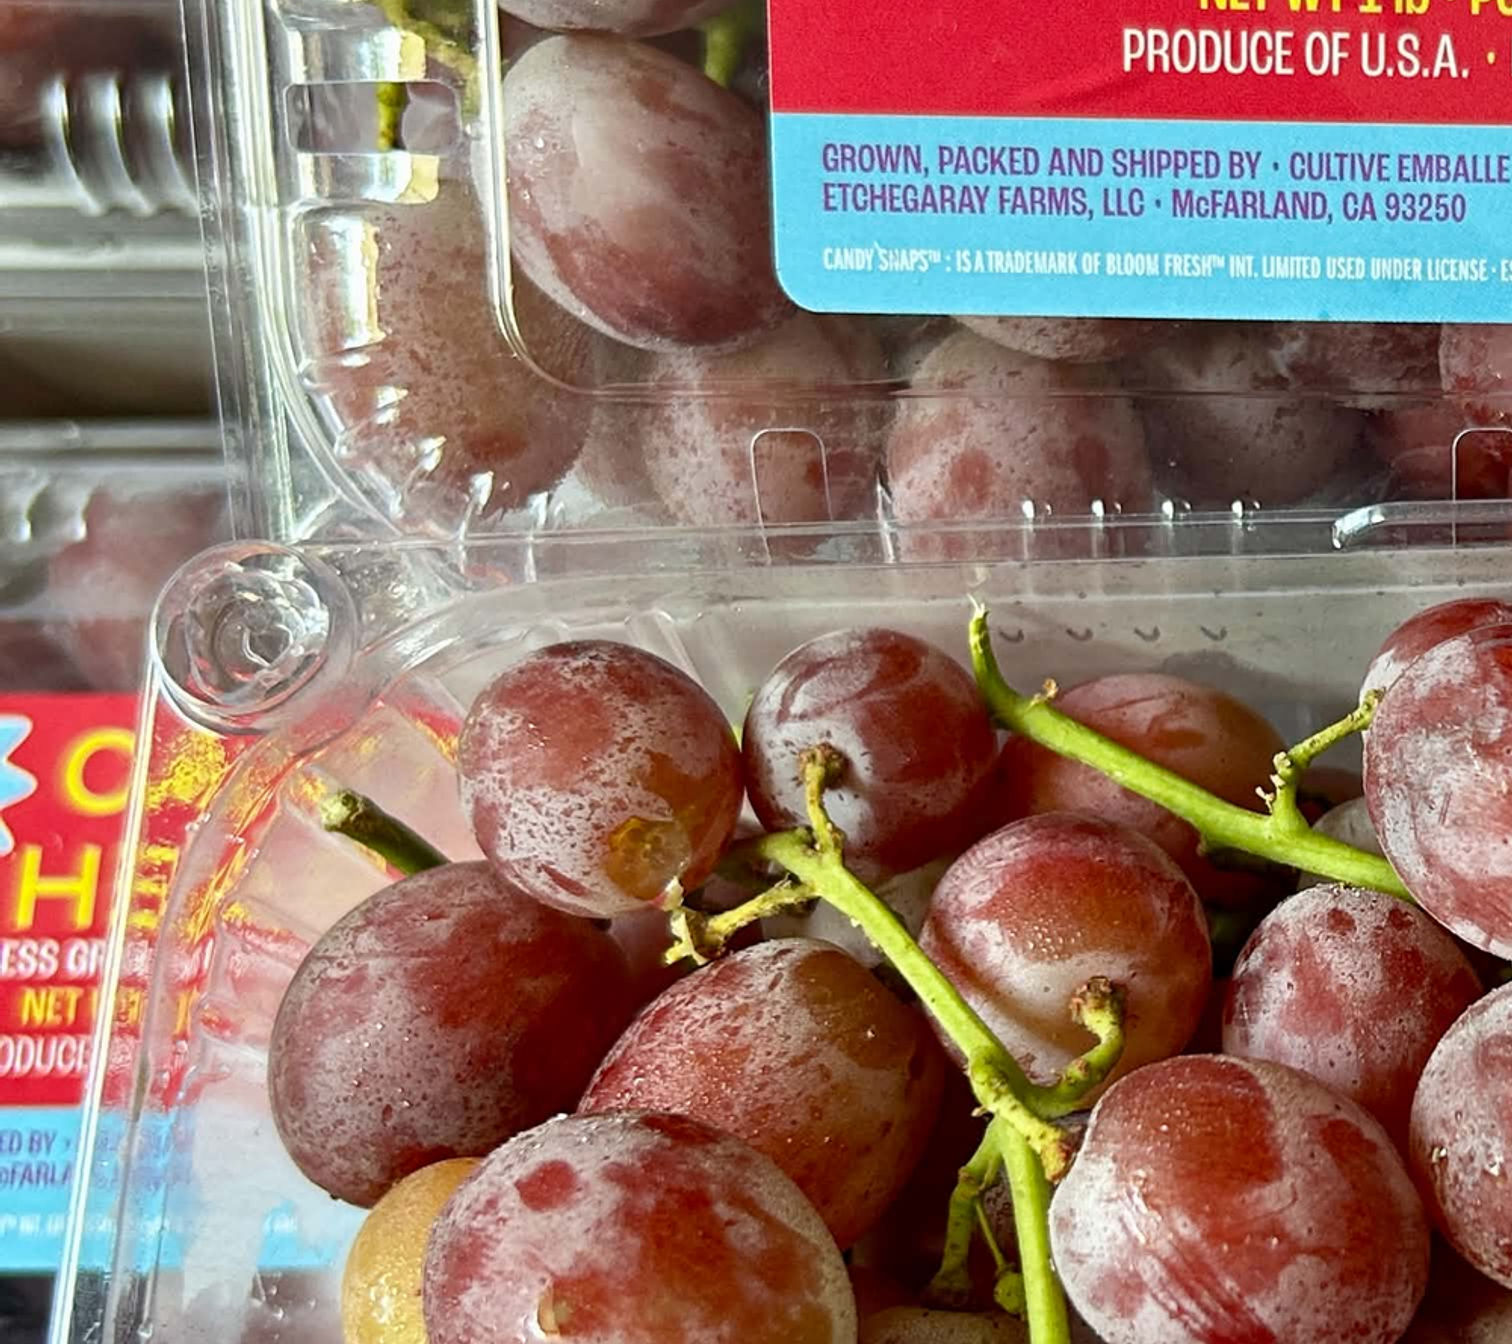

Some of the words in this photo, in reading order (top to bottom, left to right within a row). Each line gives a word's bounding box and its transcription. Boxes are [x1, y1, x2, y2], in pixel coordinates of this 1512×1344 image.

[1122, 27, 1294, 74] PRODUCE
[1305, 32, 1349, 76] OF
[1361, 32, 1469, 78] U.S.A.
[823, 144, 930, 178] GROWN,
[939, 146, 1040, 177] PACKED
[1048, 147, 1103, 177] AND
[1112, 149, 1220, 180] SHIPPED
[1229, 151, 1261, 180] BY
[1290, 152, 1389, 183] CULTIVE
[1400, 153, 1510, 184] EMBALLE
[823, 183, 990, 214] ETCHEGARAY
[999, 186, 1094, 221] FARMS,
[1103, 188, 1145, 217] LLC
[1172, 191, 1333, 225] McFARLAND,
[1343, 193, 1377, 222] CA
[1385, 194, 1466, 222] 93250
[823, 248, 875, 272] CANDY
[956, 250, 973, 273] IS
[974, 251, 986, 273] A
[986, 251, 1078, 275] TRADEMARK
[1082, 252, 1101, 274] OF
[1106, 252, 1160, 276] BLOOM
[1229, 255, 1260, 278] INT.
[1263, 256, 1321, 280] LIMITED
[1326, 258, 1366, 281] USED
[1370, 258, 1422, 282] UNDER
[1428, 259, 1488, 282] LICENSE
[21, 987, 83, 1027] NET
